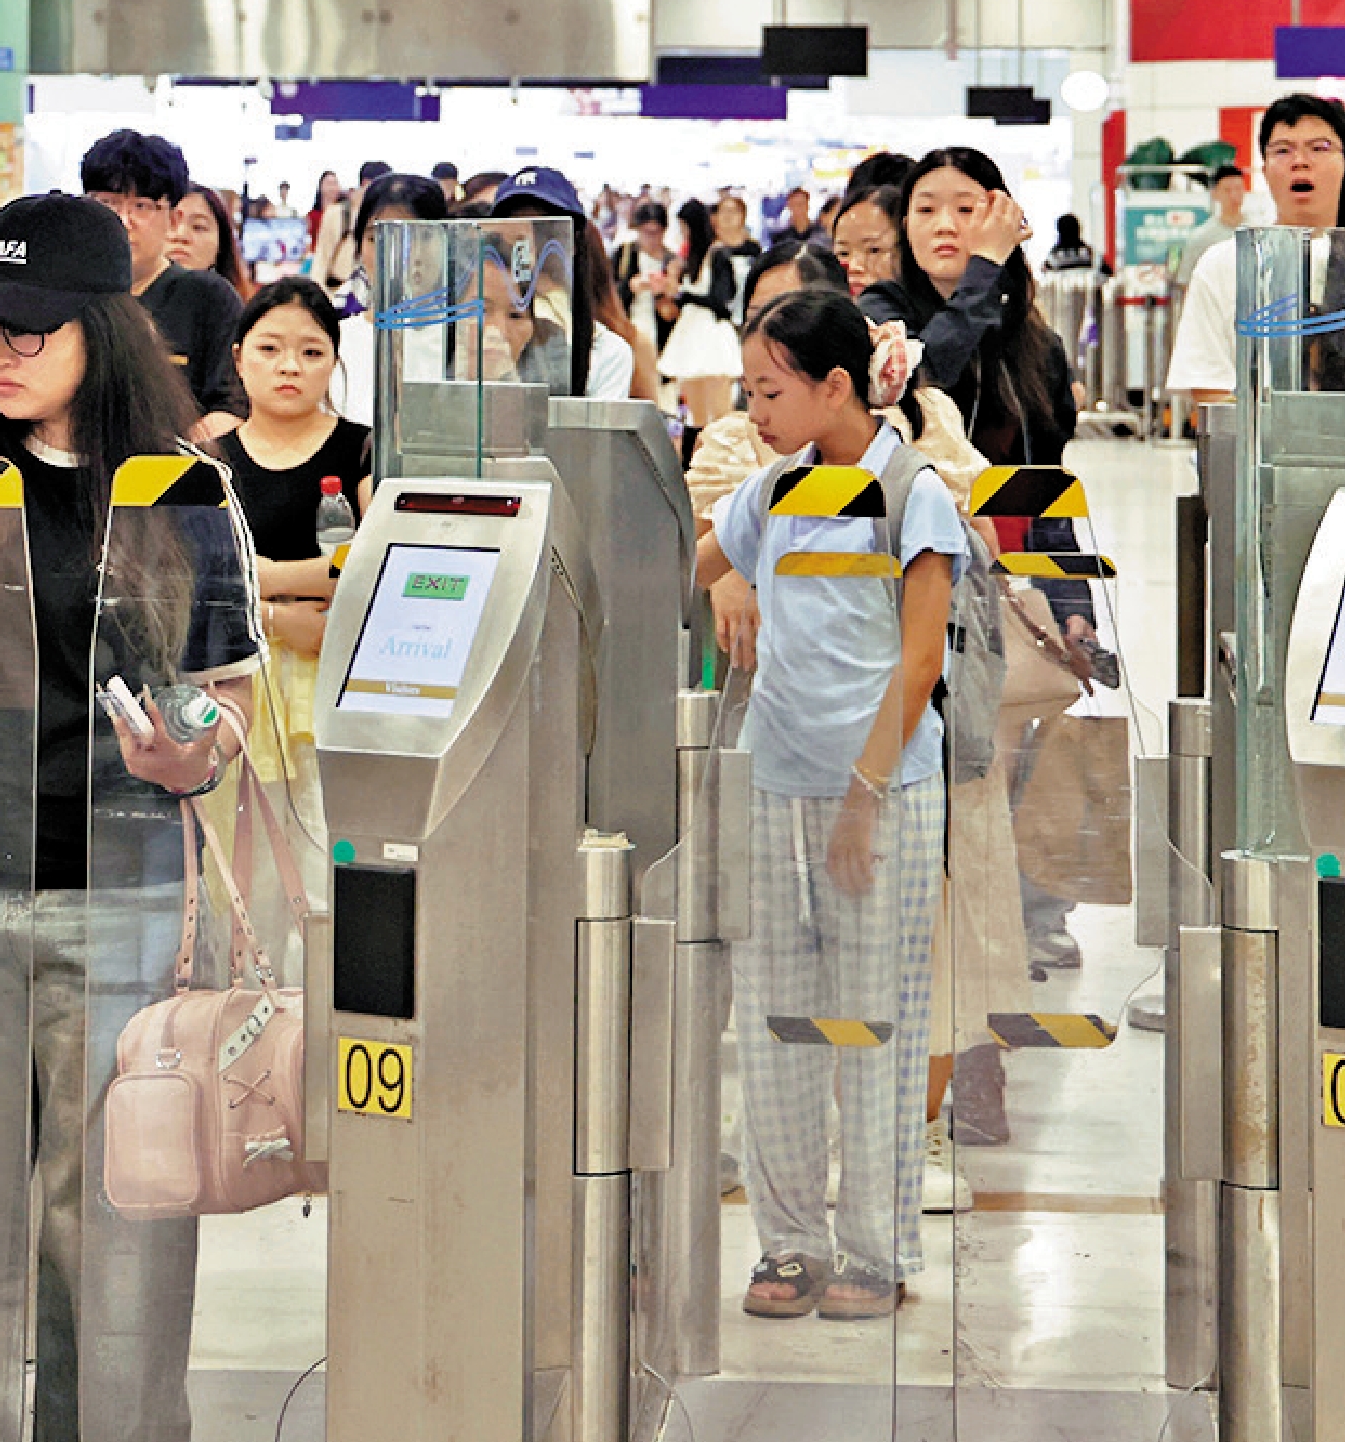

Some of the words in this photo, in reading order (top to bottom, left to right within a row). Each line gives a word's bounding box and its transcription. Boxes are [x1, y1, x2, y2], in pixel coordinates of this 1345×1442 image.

[411, 574, 465, 592] EXIT
[379, 635, 453, 659] Arrival
[345, 1044, 404, 1113] 09
